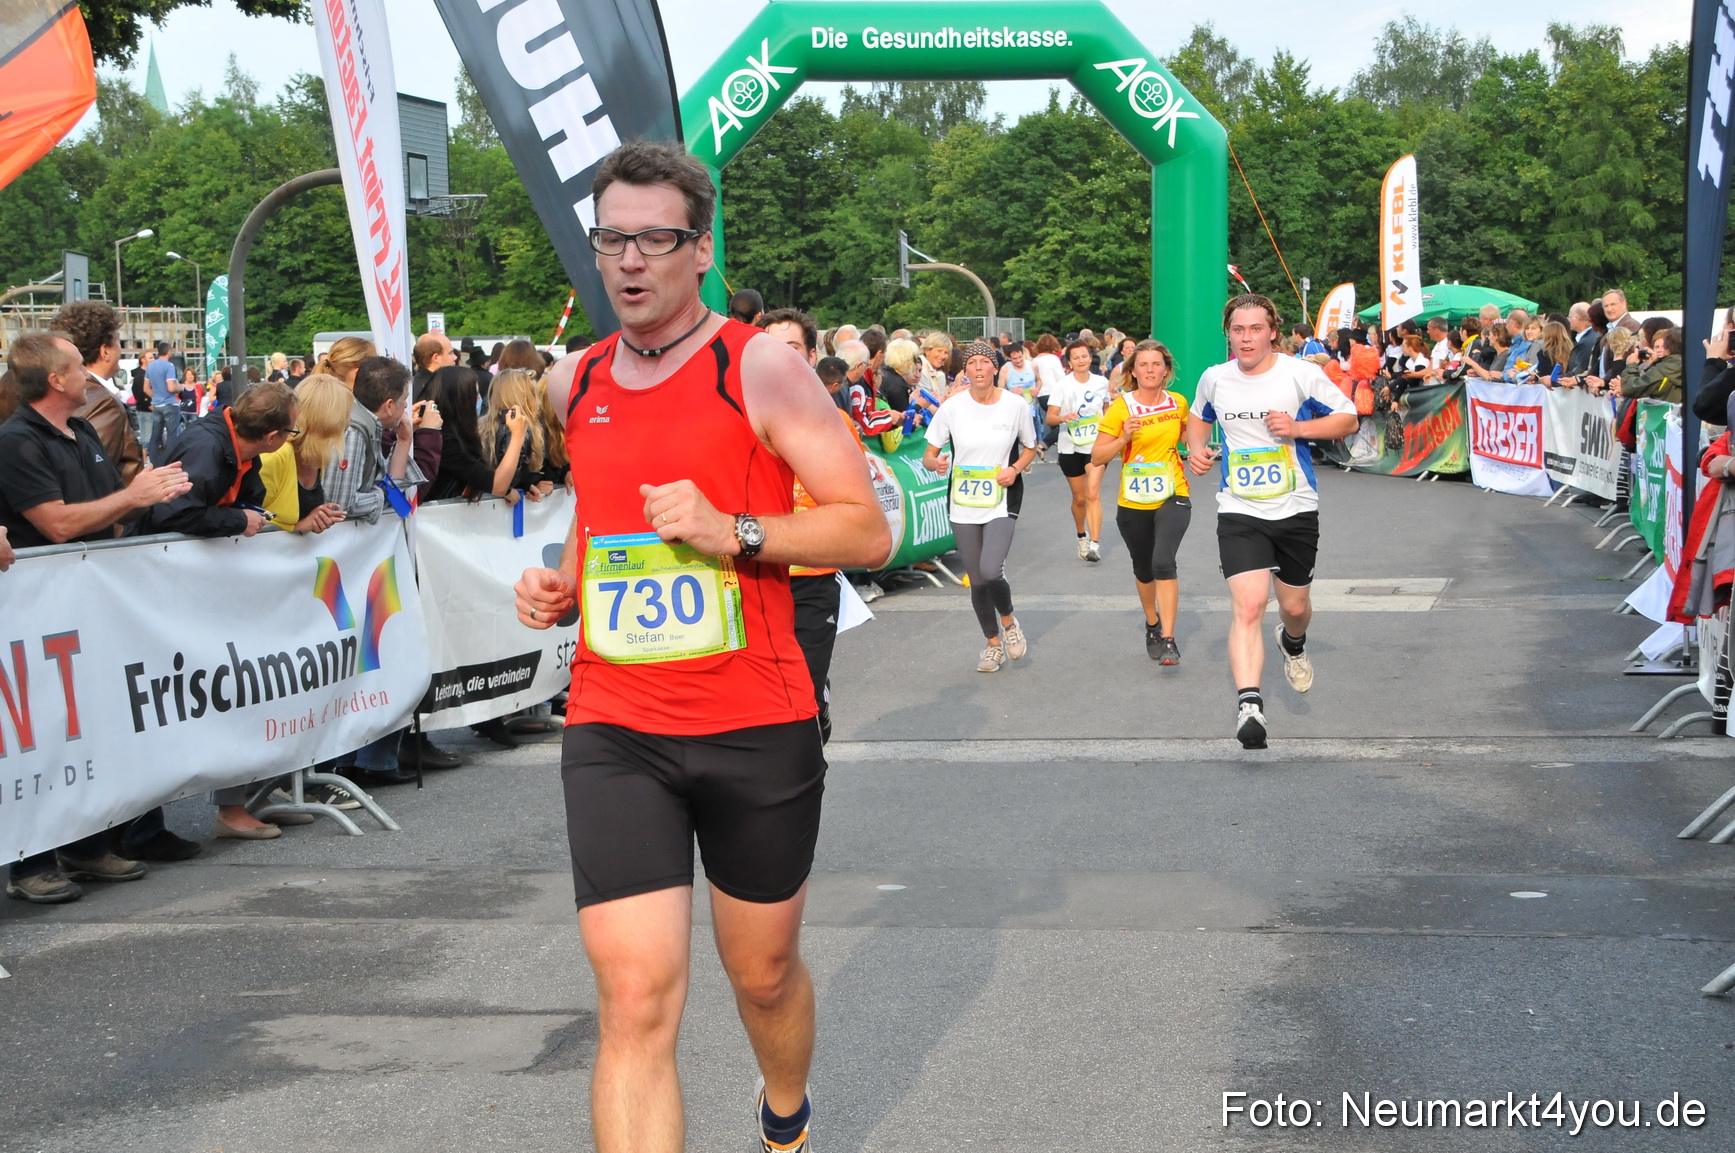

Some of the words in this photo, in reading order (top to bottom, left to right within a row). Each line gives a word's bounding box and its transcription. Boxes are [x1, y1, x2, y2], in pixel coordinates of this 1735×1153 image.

[811, 26, 848, 49] Die
[862, 26, 1073, 49] Gesundheitskasse.
[707, 37, 798, 156] AOK
[1092, 57, 1201, 149] AOK
[1392, 176, 1405, 273] KLEBL
[589, 416, 610, 424] erima
[1157, 412, 1180, 423] BÖGL
[1224, 411, 1288, 421] DELP
[1074, 424, 1097, 437] 472
[1475, 405, 1538, 464] MEIER
[1129, 476, 1164, 493] 413
[1237, 464, 1282, 487] 926
[958, 479, 993, 496] 479
[600, 559, 646, 572] firmenlauf
[598, 574, 705, 631] 730
[626, 632, 665, 644] Stefan
[124, 634, 357, 733] Frischmann
[435, 680, 466, 702] Leistung,
[466, 675, 485, 692] die
[487, 665, 531, 689] verbinden
[265, 708, 315, 742] Druck
[331, 687, 390, 721] Medien
[0, 759, 94, 805] ET.DE
